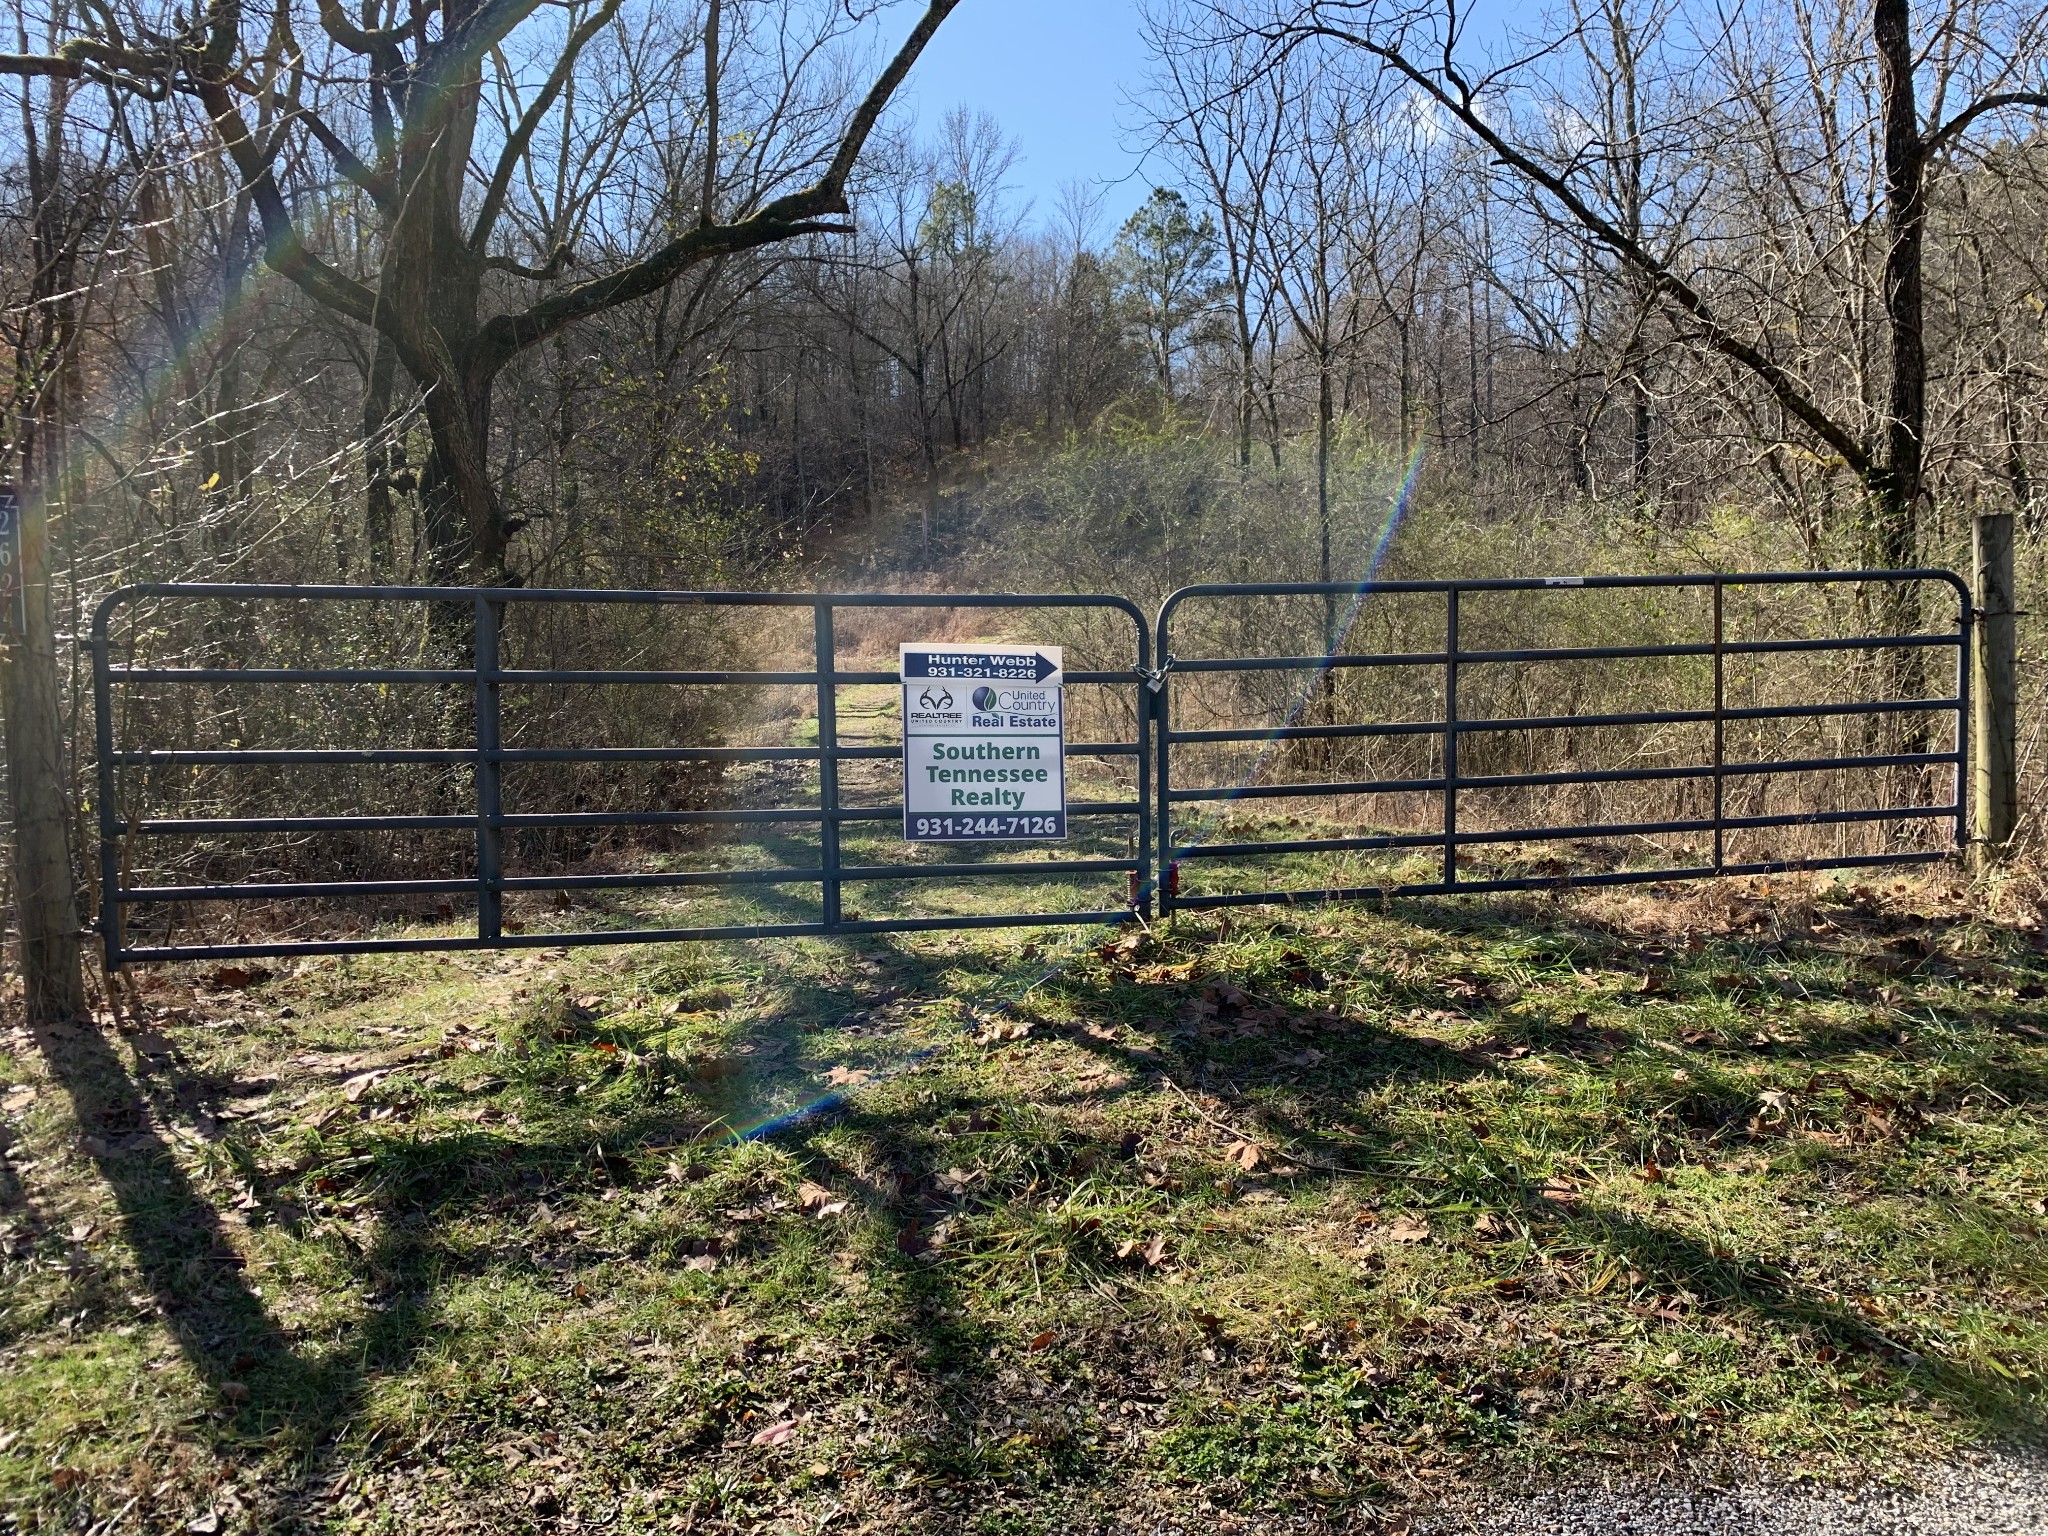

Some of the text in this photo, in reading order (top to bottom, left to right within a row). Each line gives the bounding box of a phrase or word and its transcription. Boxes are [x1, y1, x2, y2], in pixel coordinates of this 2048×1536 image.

[928, 654, 1037, 667] Hunter Webb
[927, 667, 1037, 679] 931-321-8226
[998, 691, 1056, 713] Country
[1012, 691, 1045, 700] United
[972, 715, 1004, 728] Real
[1009, 715, 1057, 728] Estate
[932, 742, 1040, 760] Southern
[925, 765, 1048, 783] Tennessee
[951, 787, 1025, 811] Realty
[916, 816, 1057, 836] 931-244-7126
